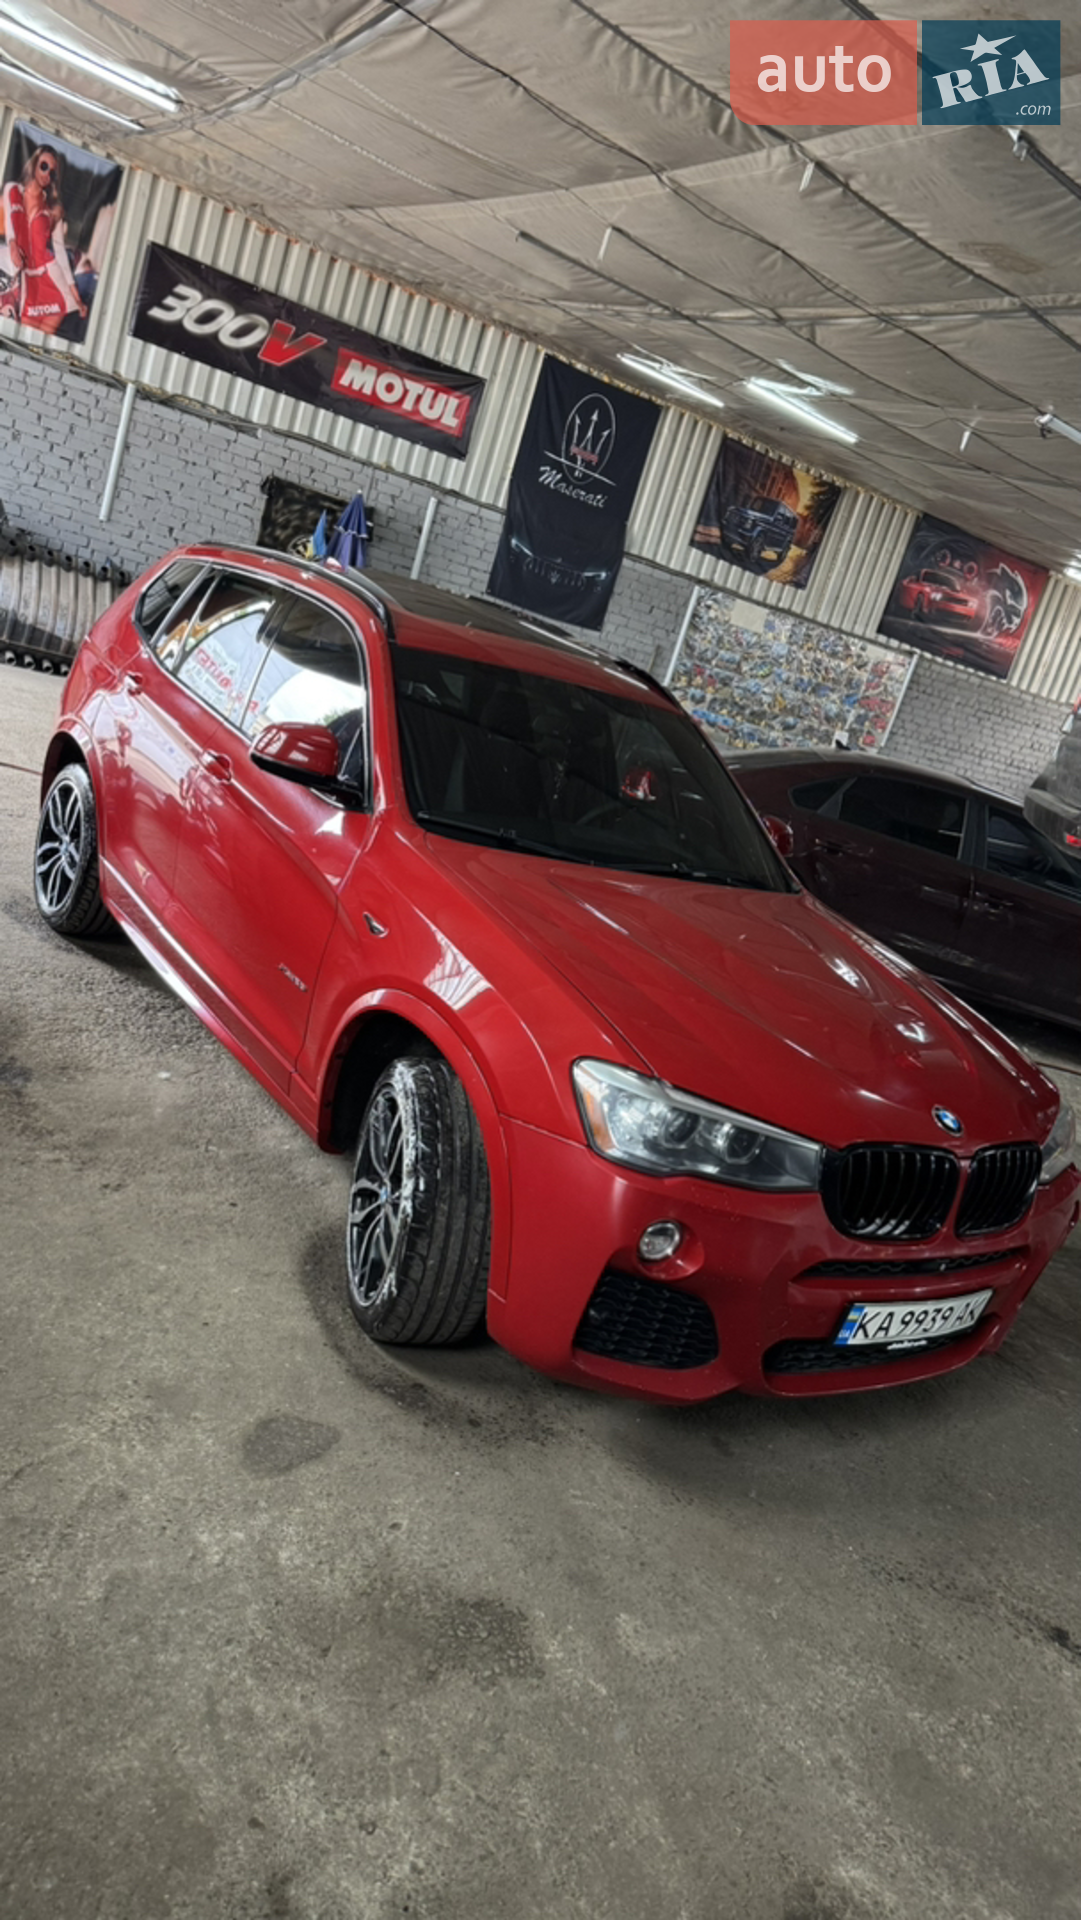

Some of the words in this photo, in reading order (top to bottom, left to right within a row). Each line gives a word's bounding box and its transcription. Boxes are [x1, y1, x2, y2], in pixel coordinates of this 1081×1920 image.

[147, 284, 328, 367] 300V
[338, 358, 461, 428] MOTUL
[538, 466, 608, 508] Maserati
[853, 1310, 895, 1339] KA
[896, 1306, 954, 1336] 9939
[951, 1295, 988, 1325] AK
